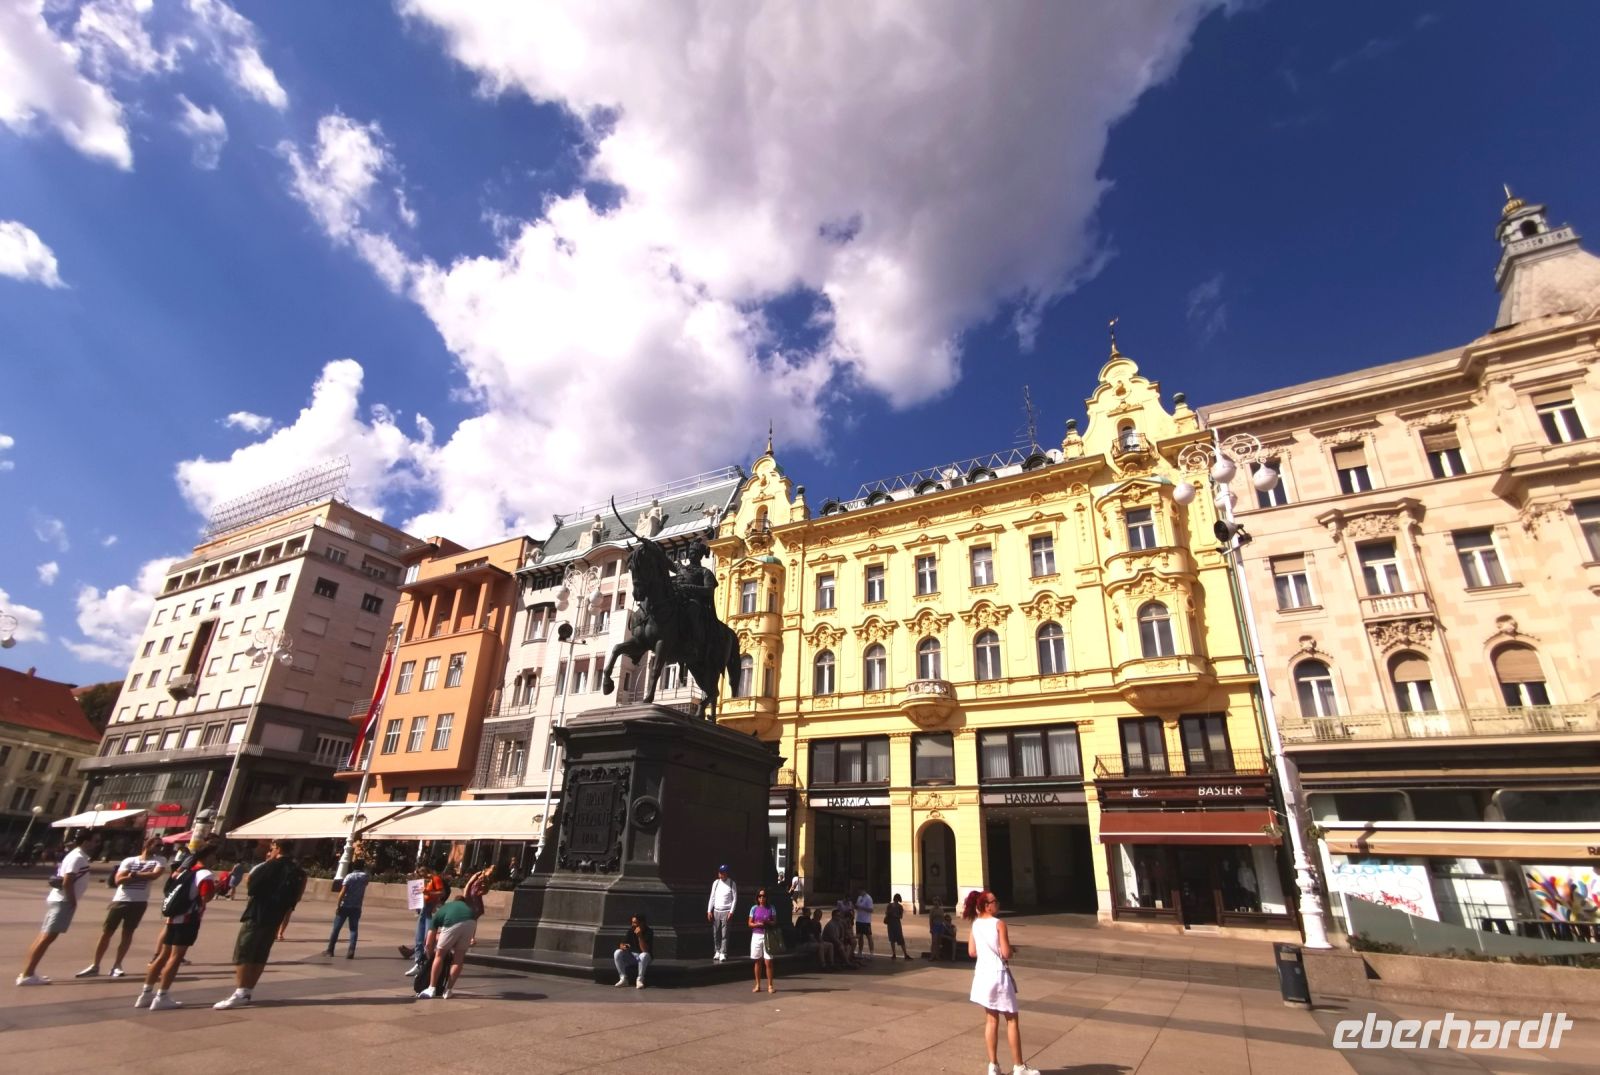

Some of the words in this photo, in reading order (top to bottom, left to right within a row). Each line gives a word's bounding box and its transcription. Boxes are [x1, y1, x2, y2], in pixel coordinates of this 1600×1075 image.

[1198, 786, 1242, 796] BASLER
[827, 796, 872, 808] HARMICA
[1004, 792, 1060, 806] HARMICA
